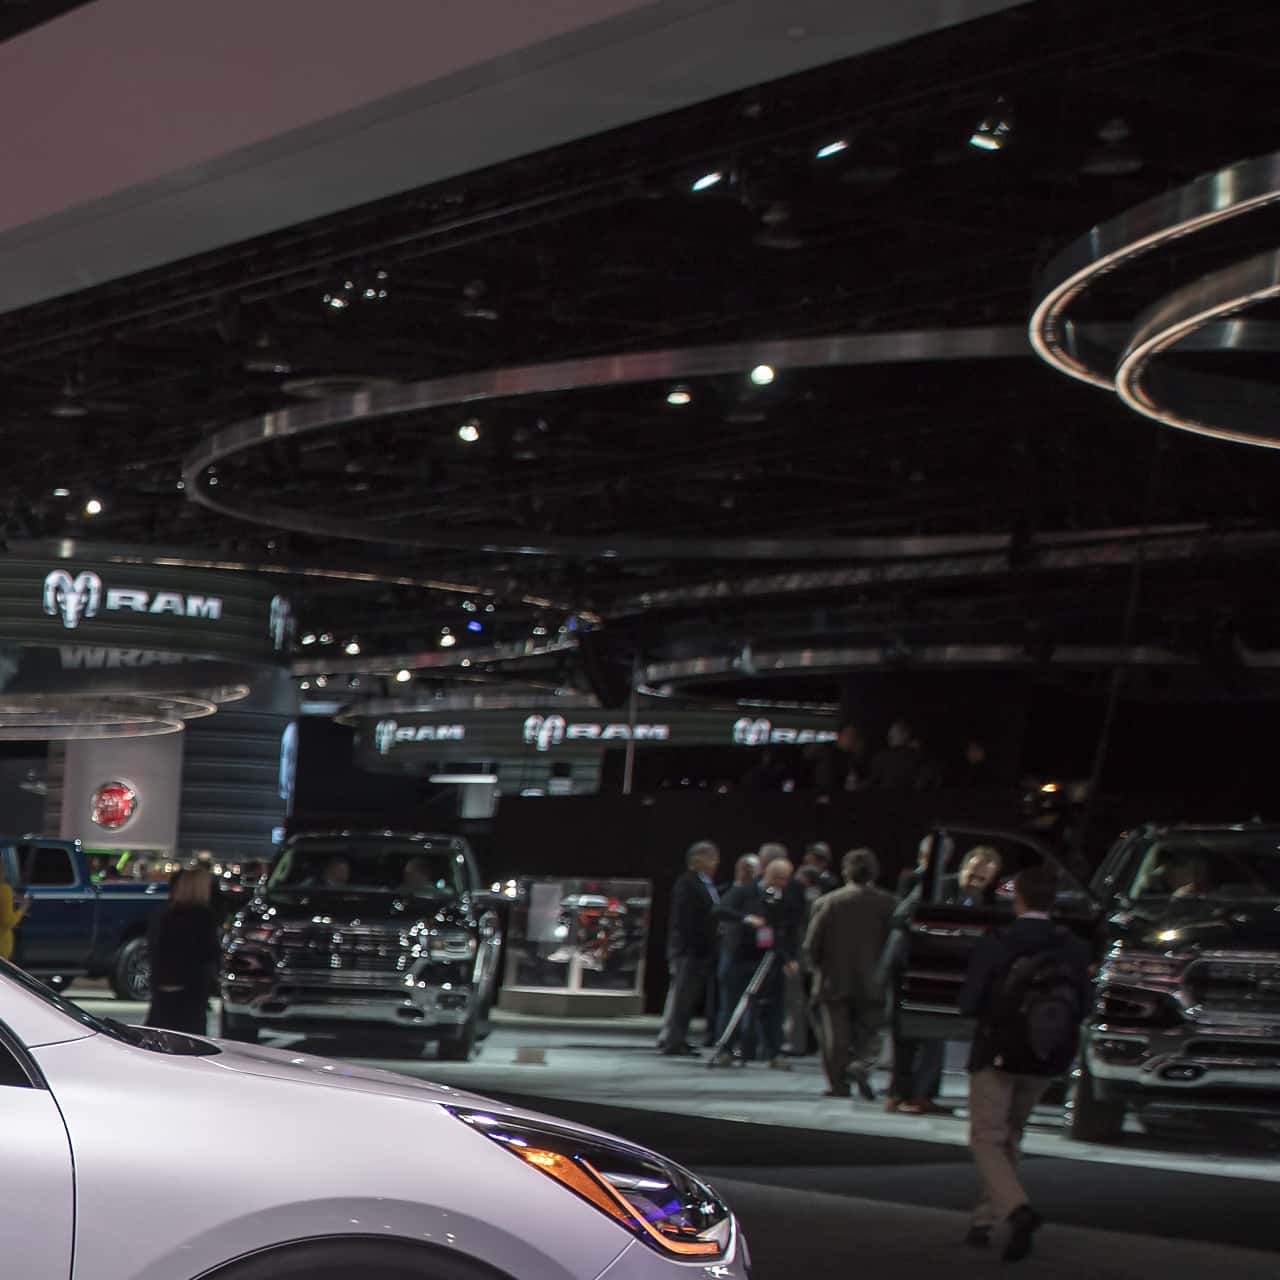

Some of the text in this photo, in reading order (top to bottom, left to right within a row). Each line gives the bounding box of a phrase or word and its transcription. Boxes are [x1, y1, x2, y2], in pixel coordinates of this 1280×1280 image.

[106, 588, 224, 619] RAM
[395, 725, 465, 741] RAM
[566, 724, 670, 740] RAM
